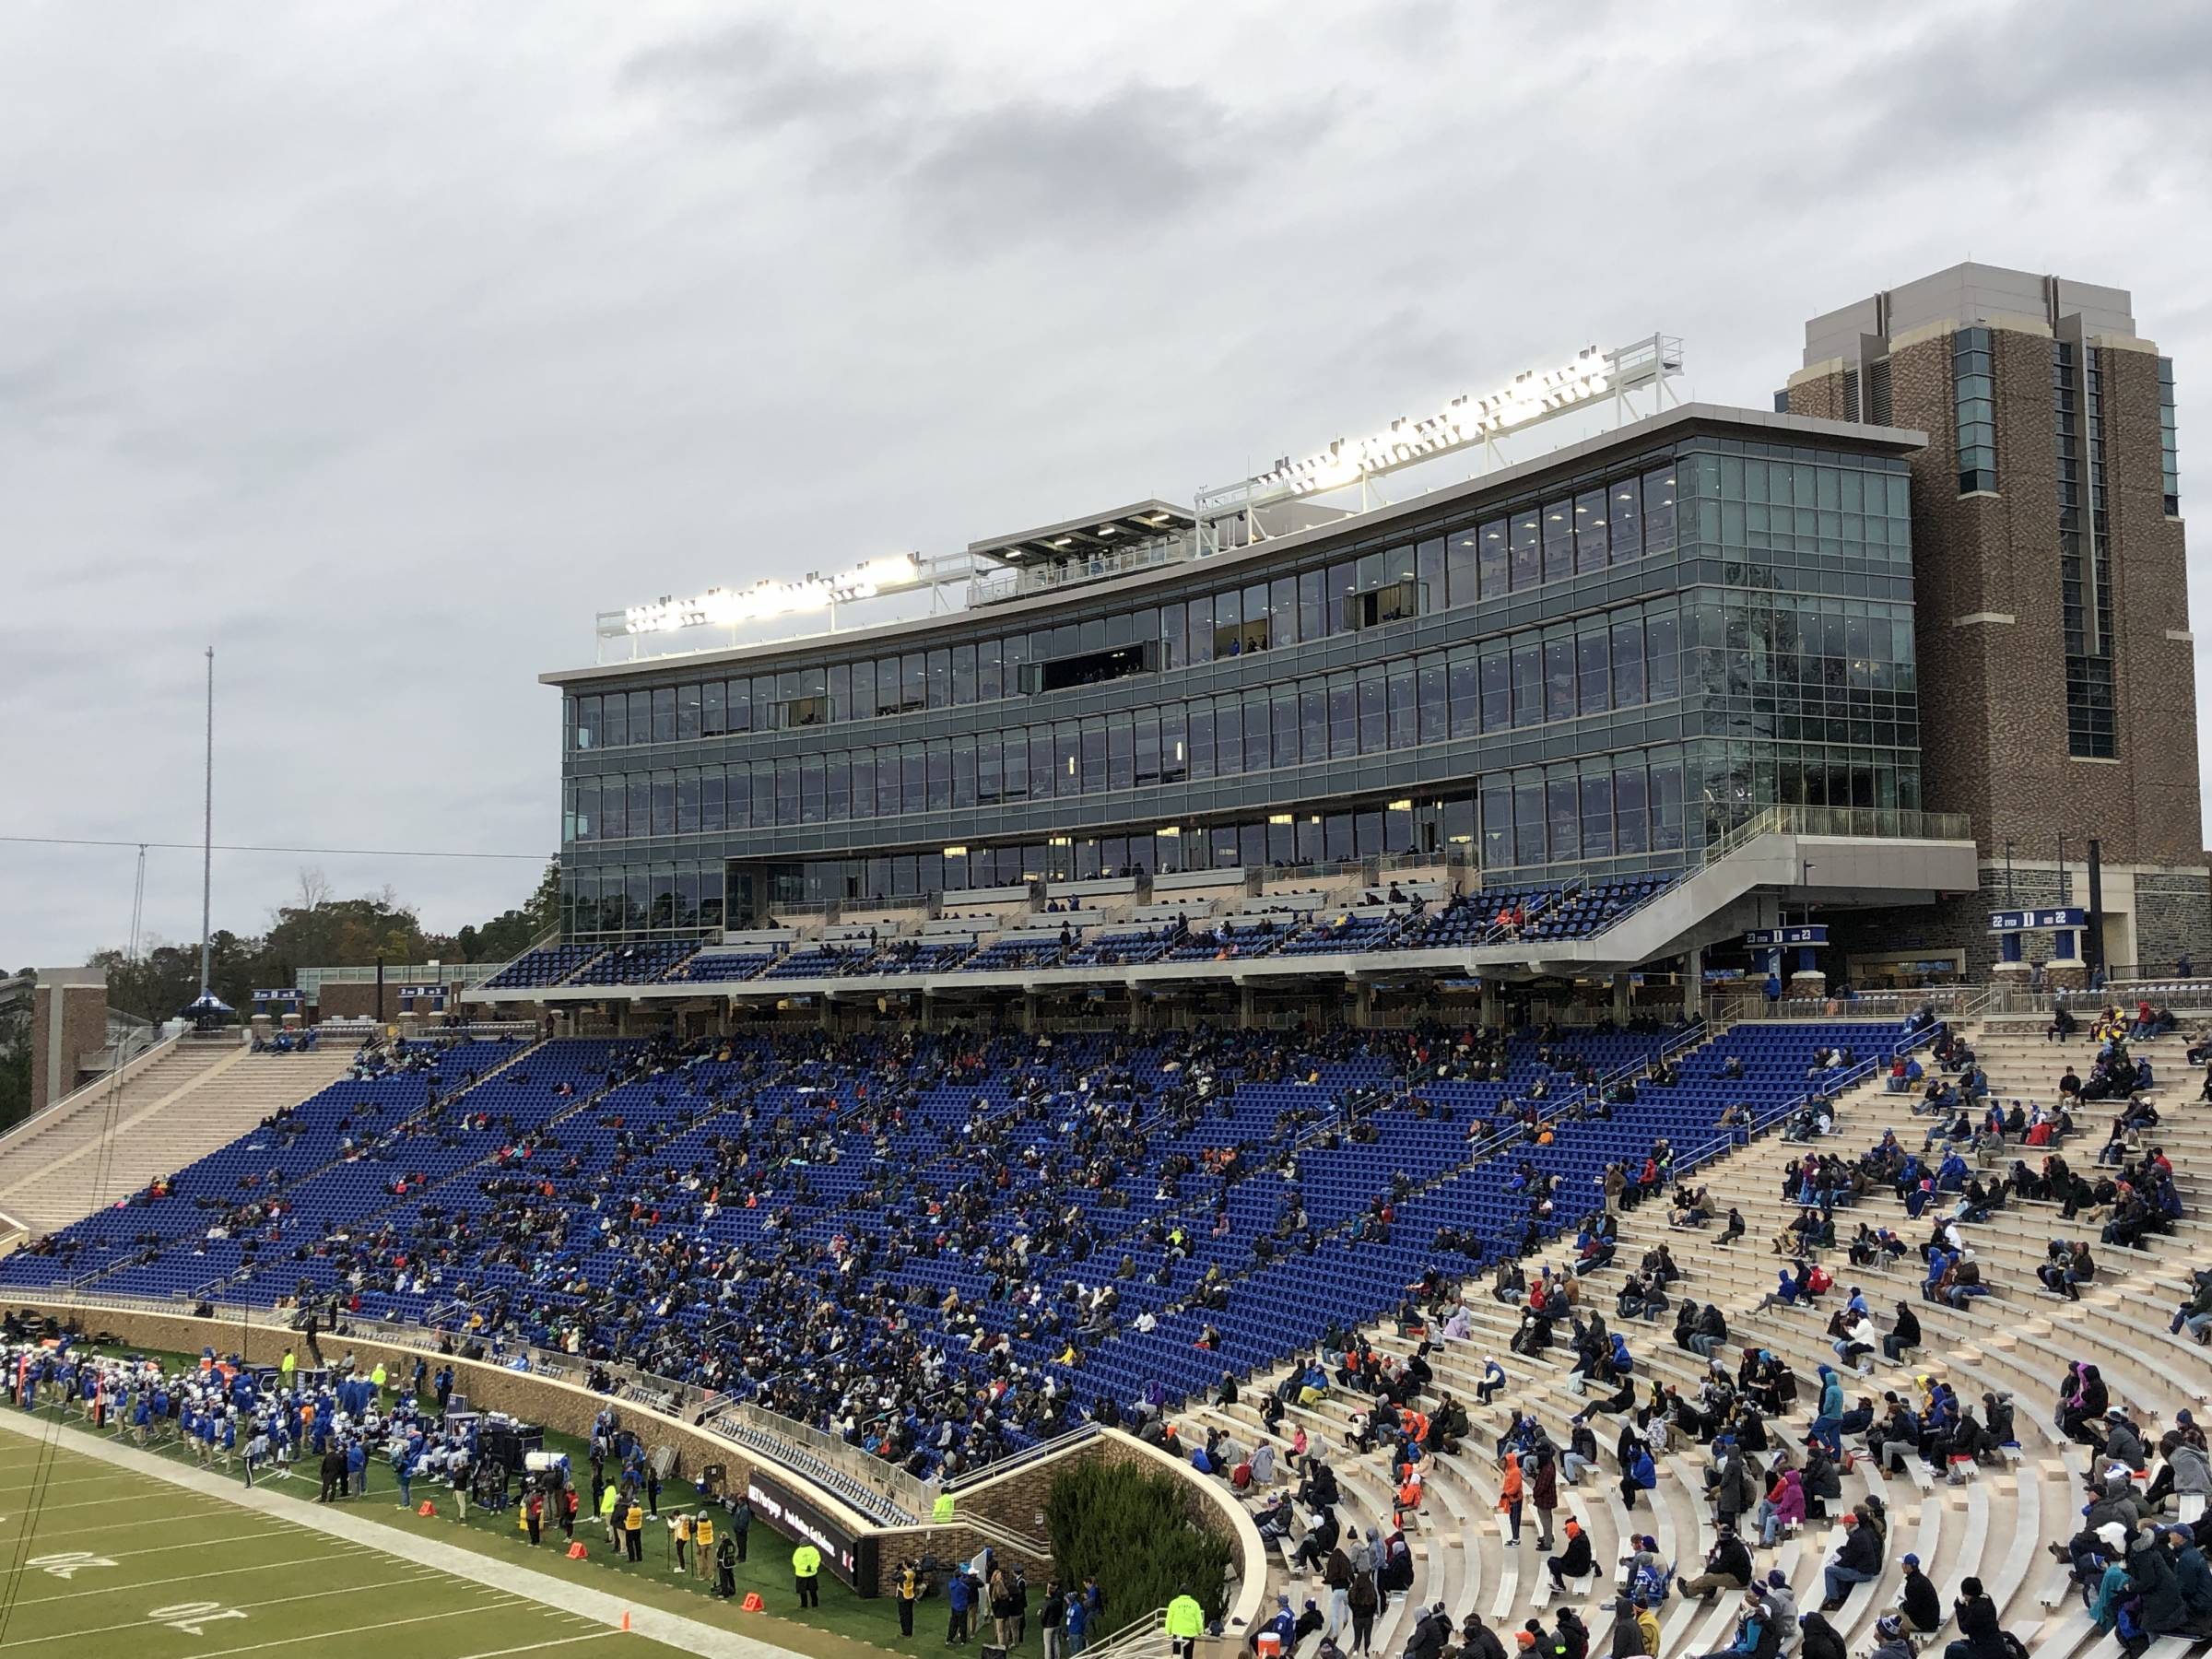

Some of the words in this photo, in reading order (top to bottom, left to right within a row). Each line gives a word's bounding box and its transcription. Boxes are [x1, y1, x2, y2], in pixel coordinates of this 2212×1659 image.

[1993, 916, 2003, 927] 22
[2023, 912, 2034, 927] D
[2055, 912, 2066, 924] 22
[1747, 933, 1756, 943] 23
[1773, 930, 1783, 943] D
[1802, 929, 1811, 940] 23
